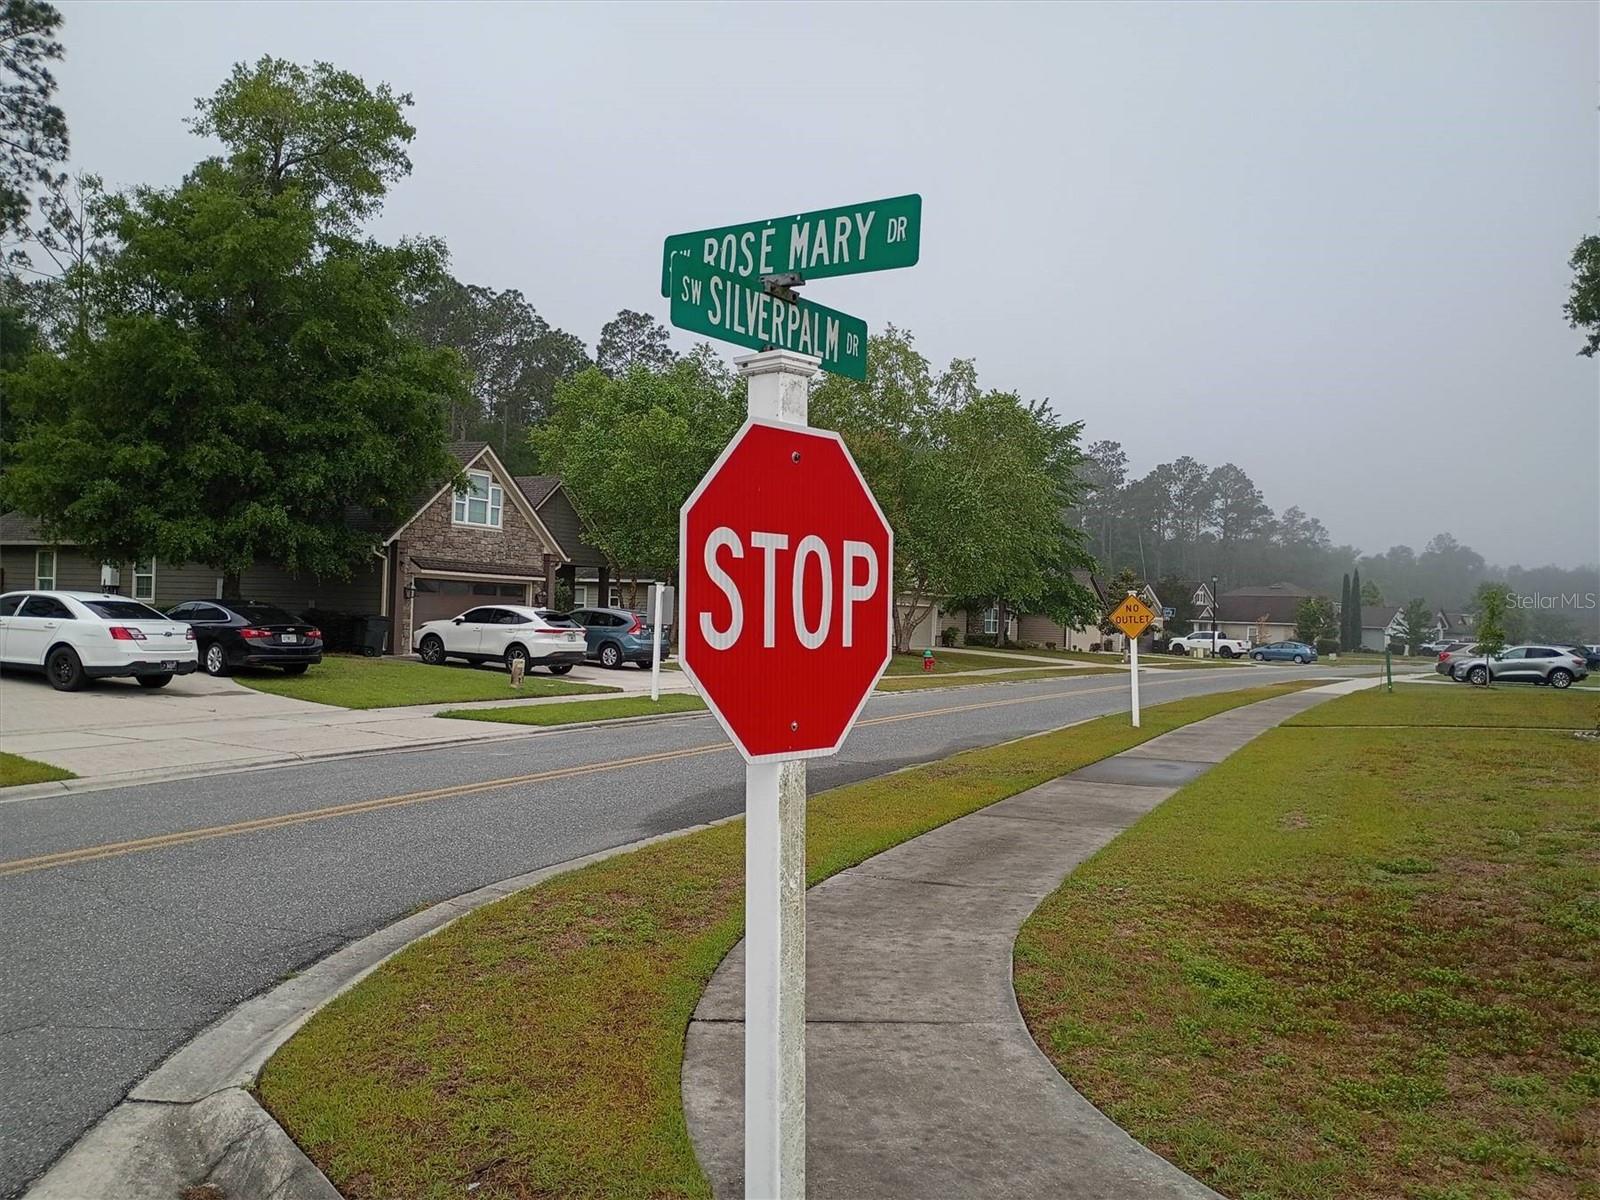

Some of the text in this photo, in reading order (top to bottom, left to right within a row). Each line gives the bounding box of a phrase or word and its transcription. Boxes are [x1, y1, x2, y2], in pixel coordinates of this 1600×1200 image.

[703, 228, 776, 277] ROSE
[788, 211, 875, 270] MARY
[887, 216, 907, 243] DR
[681, 275, 858, 363] SW SILVERPALM DR
[699, 526, 879, 651] STOP
[1115, 615, 1149, 624] OUTLET
[1125, 604, 1139, 613] NO
